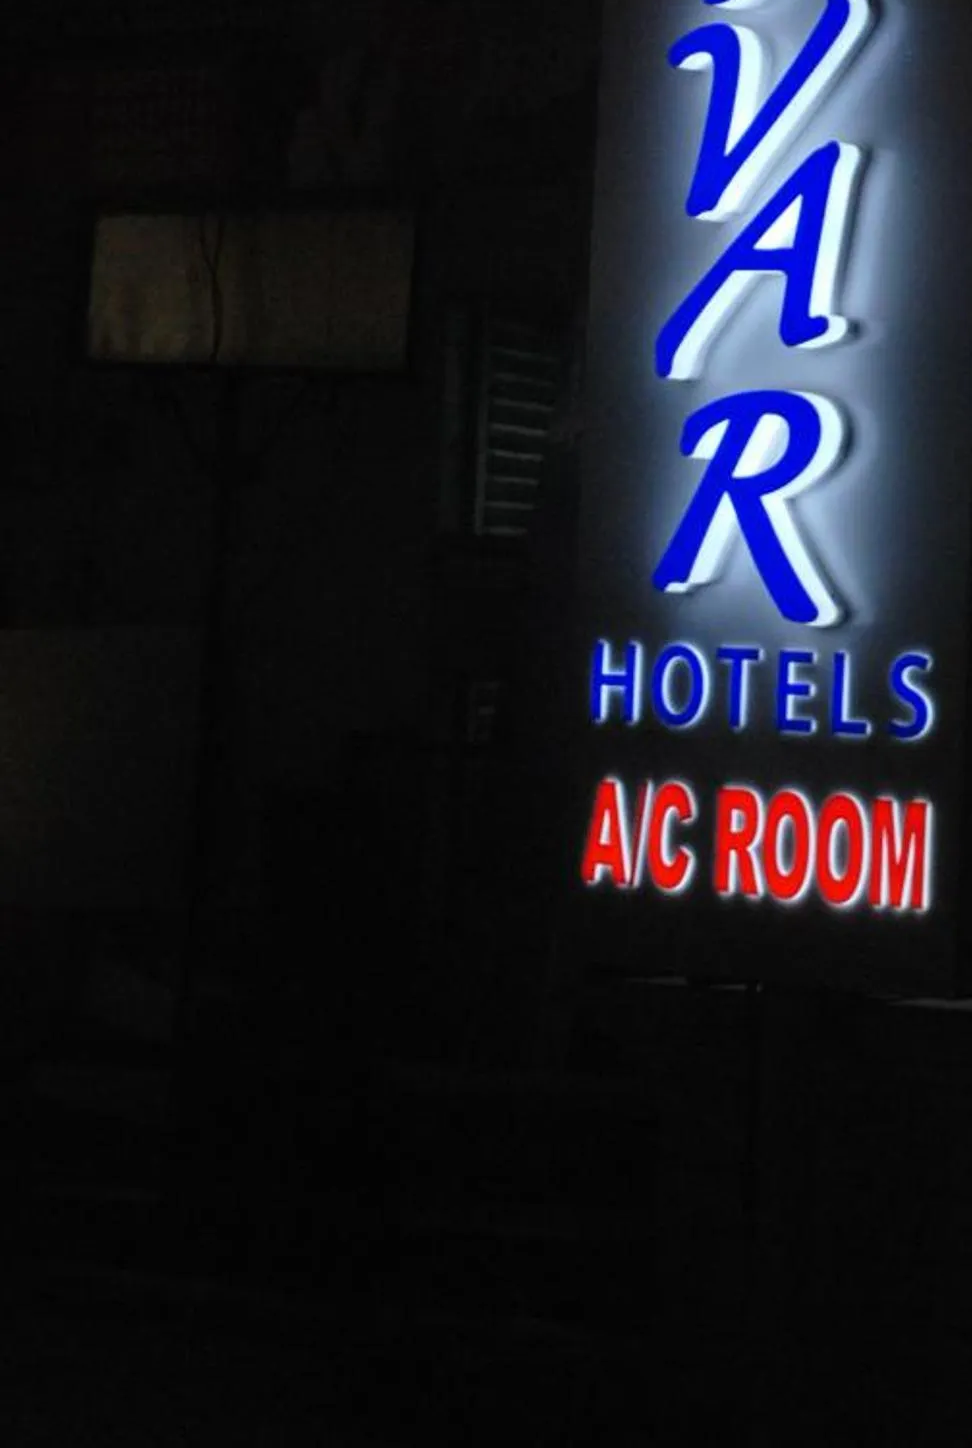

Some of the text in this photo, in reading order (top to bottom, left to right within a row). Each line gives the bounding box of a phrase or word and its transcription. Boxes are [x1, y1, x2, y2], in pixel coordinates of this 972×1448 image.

[590, 638, 935, 740] HOTELS
[580, 774, 934, 913] A/C ROOM
